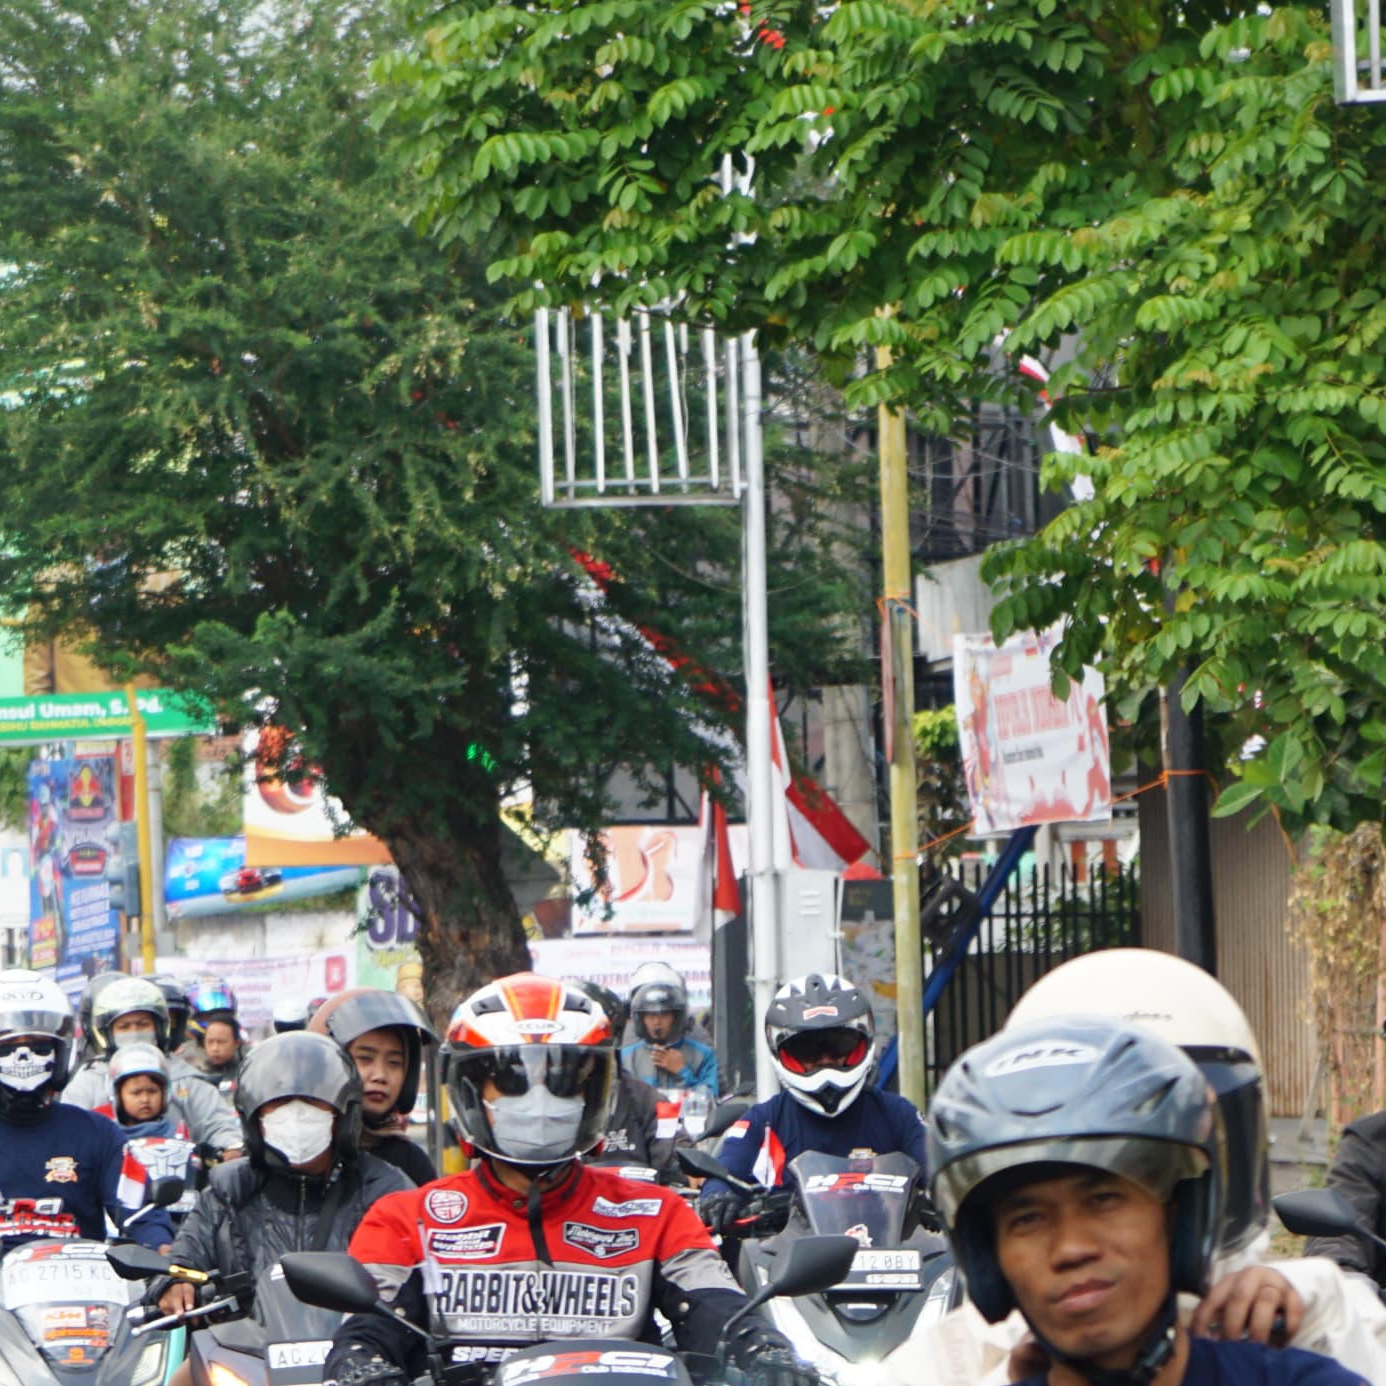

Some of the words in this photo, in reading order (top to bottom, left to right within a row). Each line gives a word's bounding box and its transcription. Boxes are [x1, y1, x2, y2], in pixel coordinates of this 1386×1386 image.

[37, 1264, 83, 1282] 2715
[457, 1318, 537, 1332] MOTORCYCLE
[541, 1319, 612, 1333] EQUIPMENT
